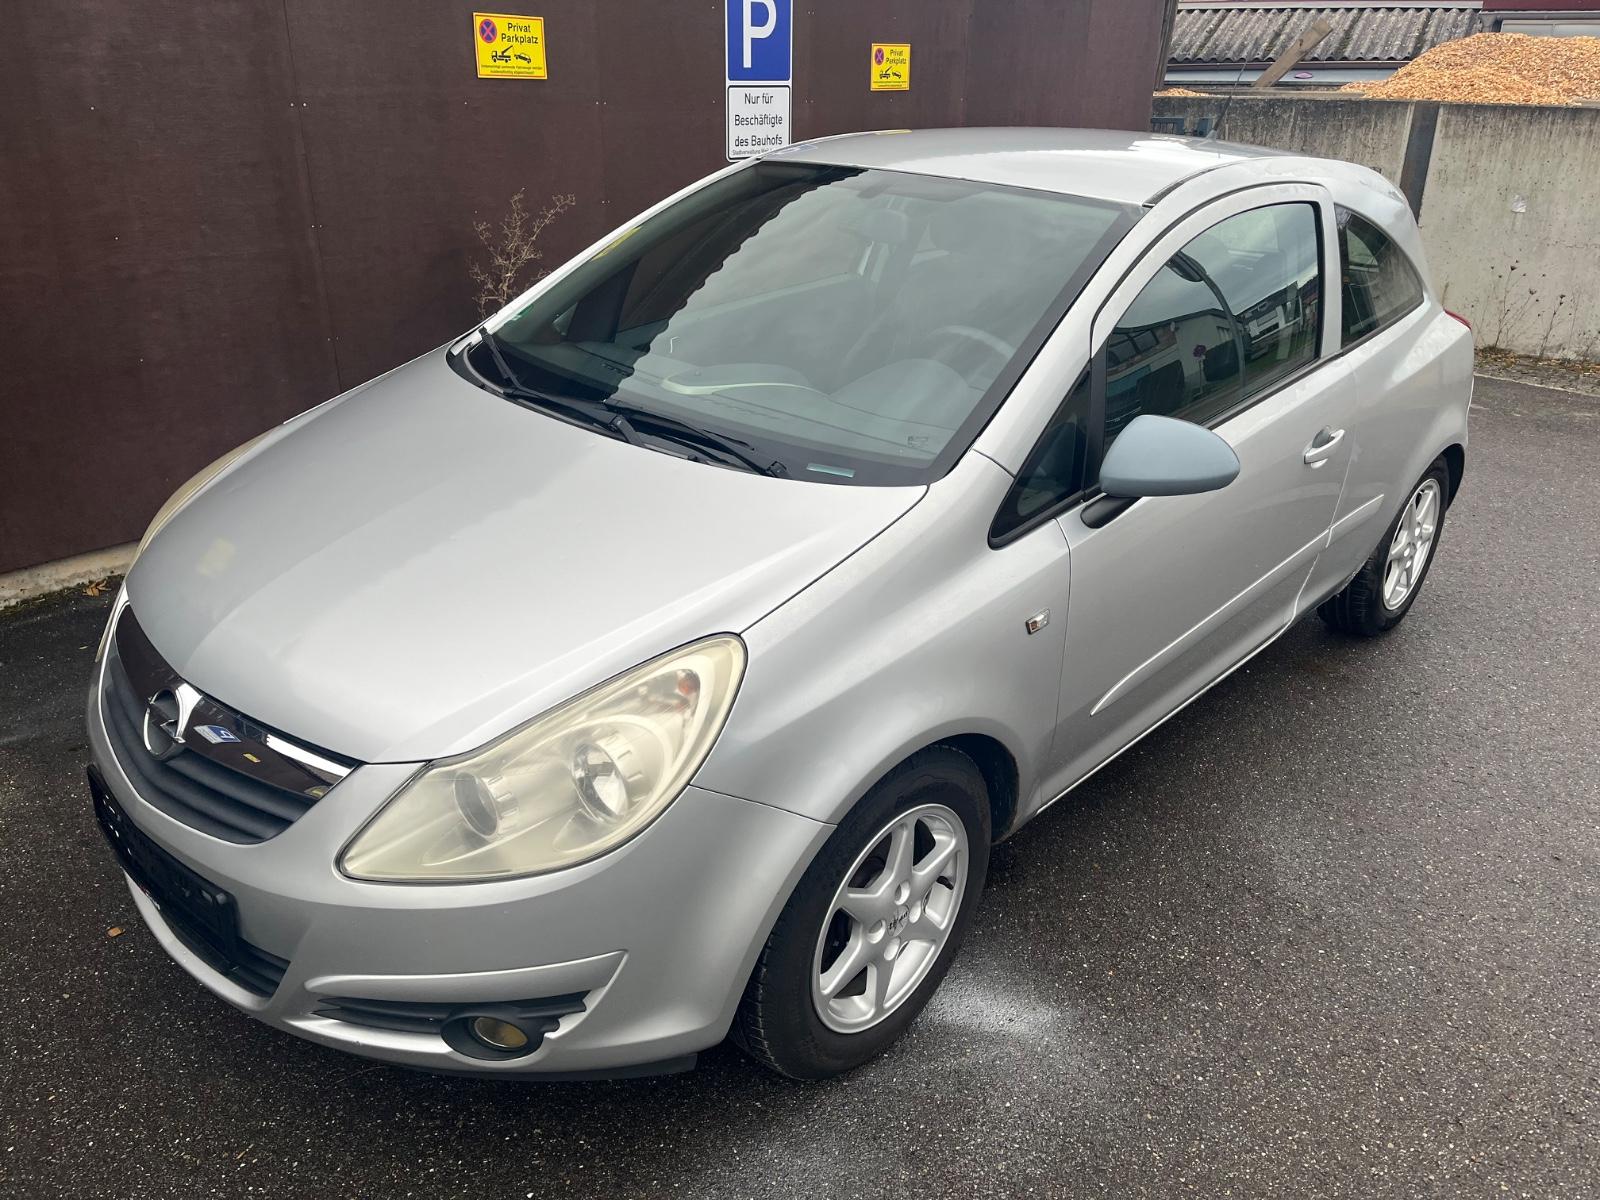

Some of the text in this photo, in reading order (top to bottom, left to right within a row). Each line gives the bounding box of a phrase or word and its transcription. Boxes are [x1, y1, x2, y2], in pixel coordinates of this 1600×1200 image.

[508, 22, 531, 32] Privat
[501, 33, 538, 44] Parkplatz
[743, 0, 776, 68] P
[744, 93, 774, 105] Nur für
[734, 113, 783, 128] Beschäftigte
[734, 134, 783, 147] des Bauhofs
